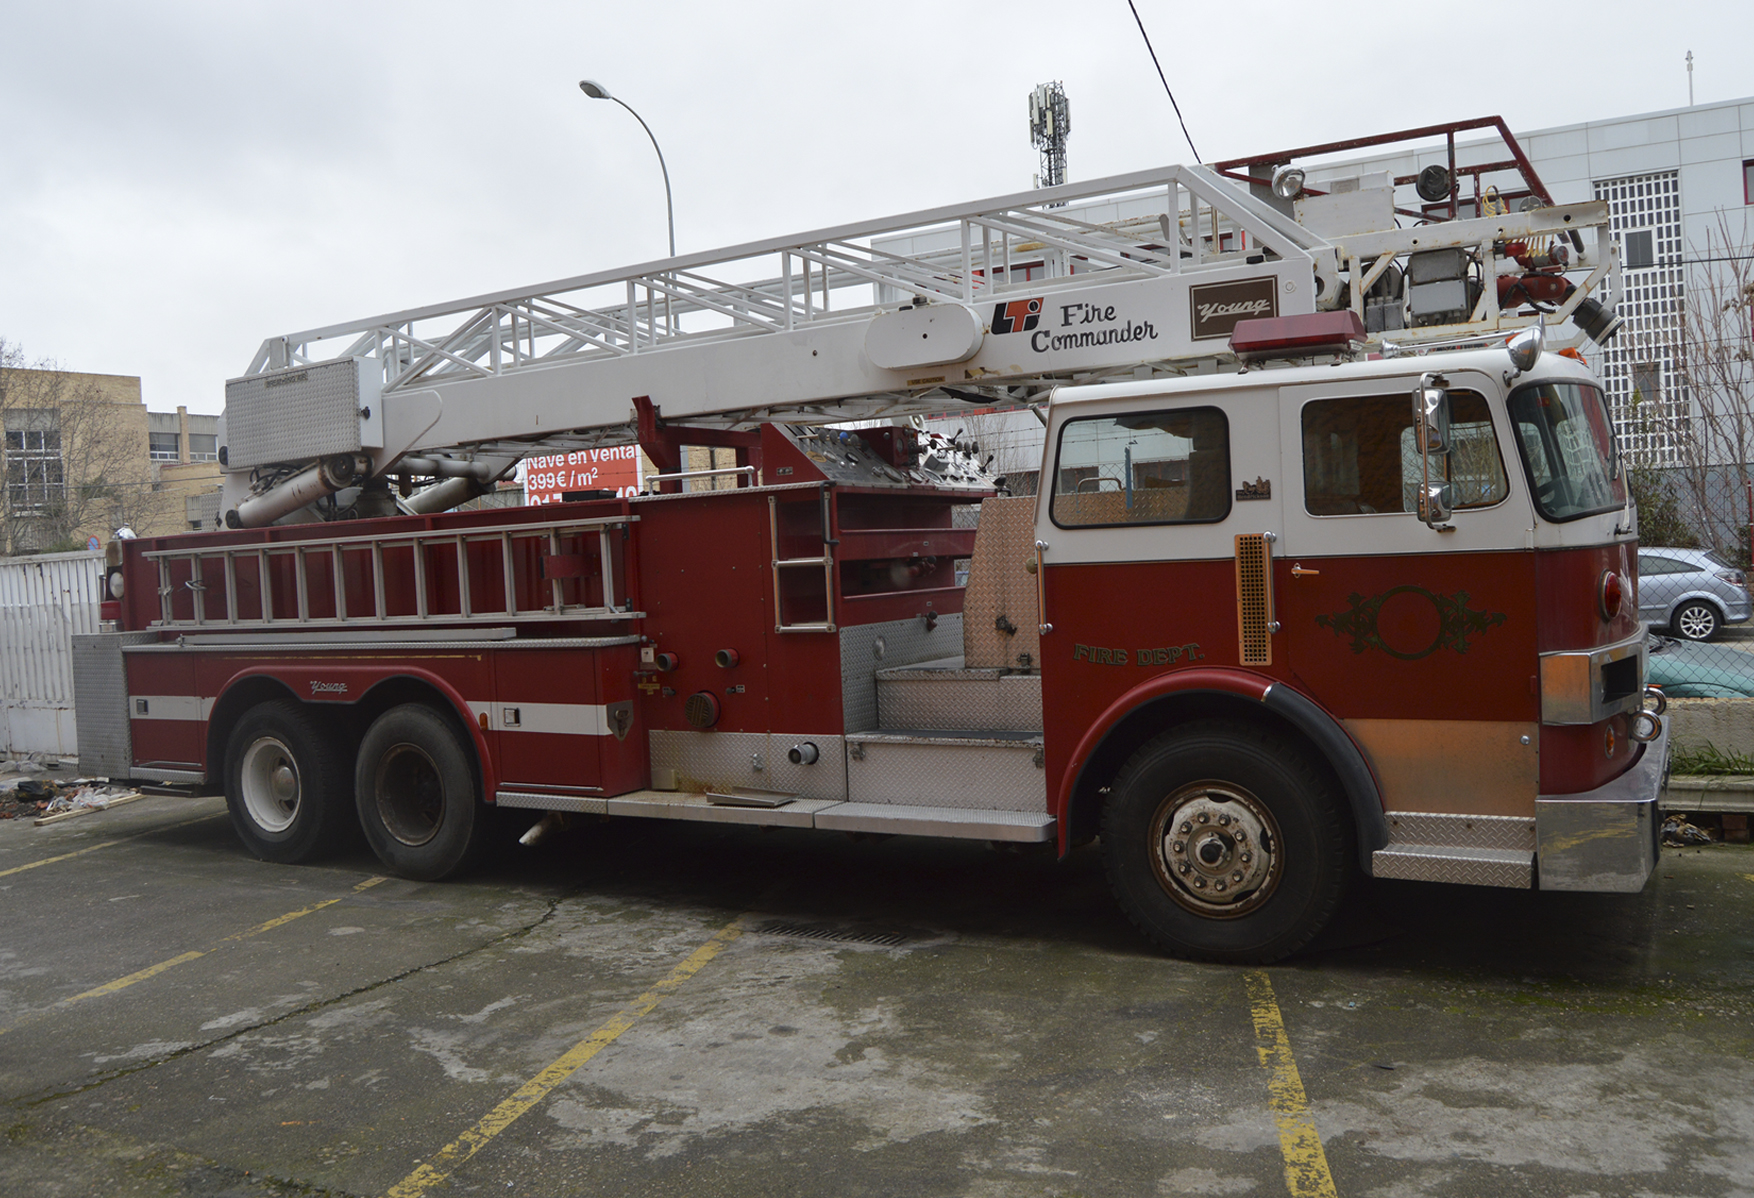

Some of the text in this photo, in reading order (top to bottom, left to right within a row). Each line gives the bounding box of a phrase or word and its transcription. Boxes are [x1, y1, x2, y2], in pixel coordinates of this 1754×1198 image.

[1060, 303, 1116, 327] Fire
[1197, 299, 1270, 323] Young
[1031, 320, 1158, 353] Commander
[527, 455, 564, 470] Nave
[567, 451, 587, 465] en
[528, 471, 567, 490] 399€
[1073, 642, 1205, 666] FIRE DEPT.
[310, 680, 348, 695] Young
